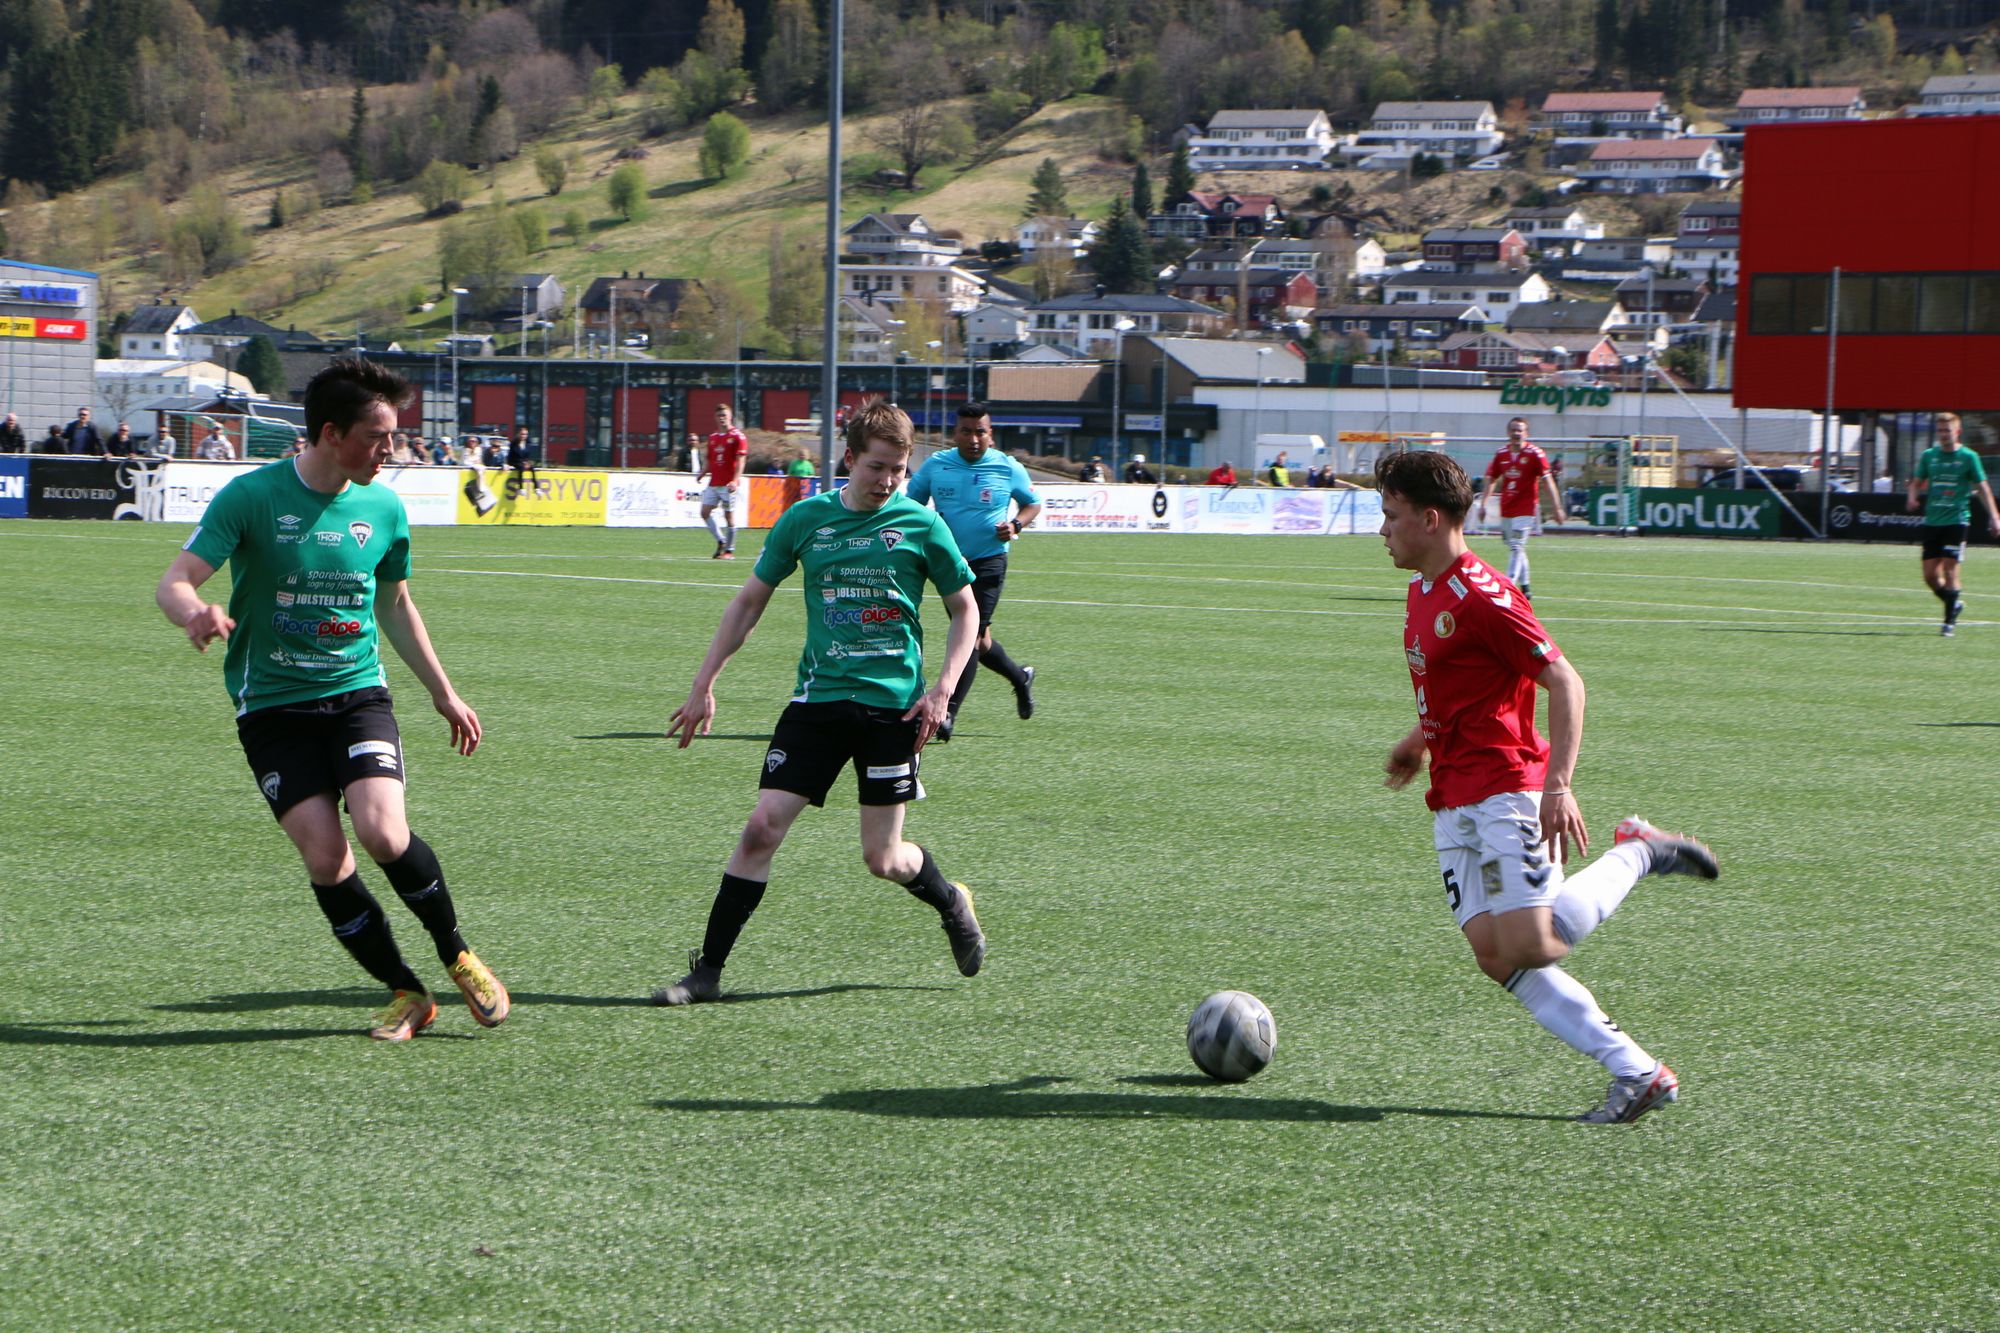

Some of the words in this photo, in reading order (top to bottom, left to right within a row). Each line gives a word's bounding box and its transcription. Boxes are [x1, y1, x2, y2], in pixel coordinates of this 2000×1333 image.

[1499, 379, 1612, 413] Europris
[168, 486, 217, 503] TRUC
[317, 533, 342, 542] THON
[848, 539, 871, 547] THON
[307, 570, 369, 582] sparebanken
[839, 565, 897, 577] sparebanken
[836, 587, 872, 598] JØLSTER
[1442, 867, 1462, 913] 5
